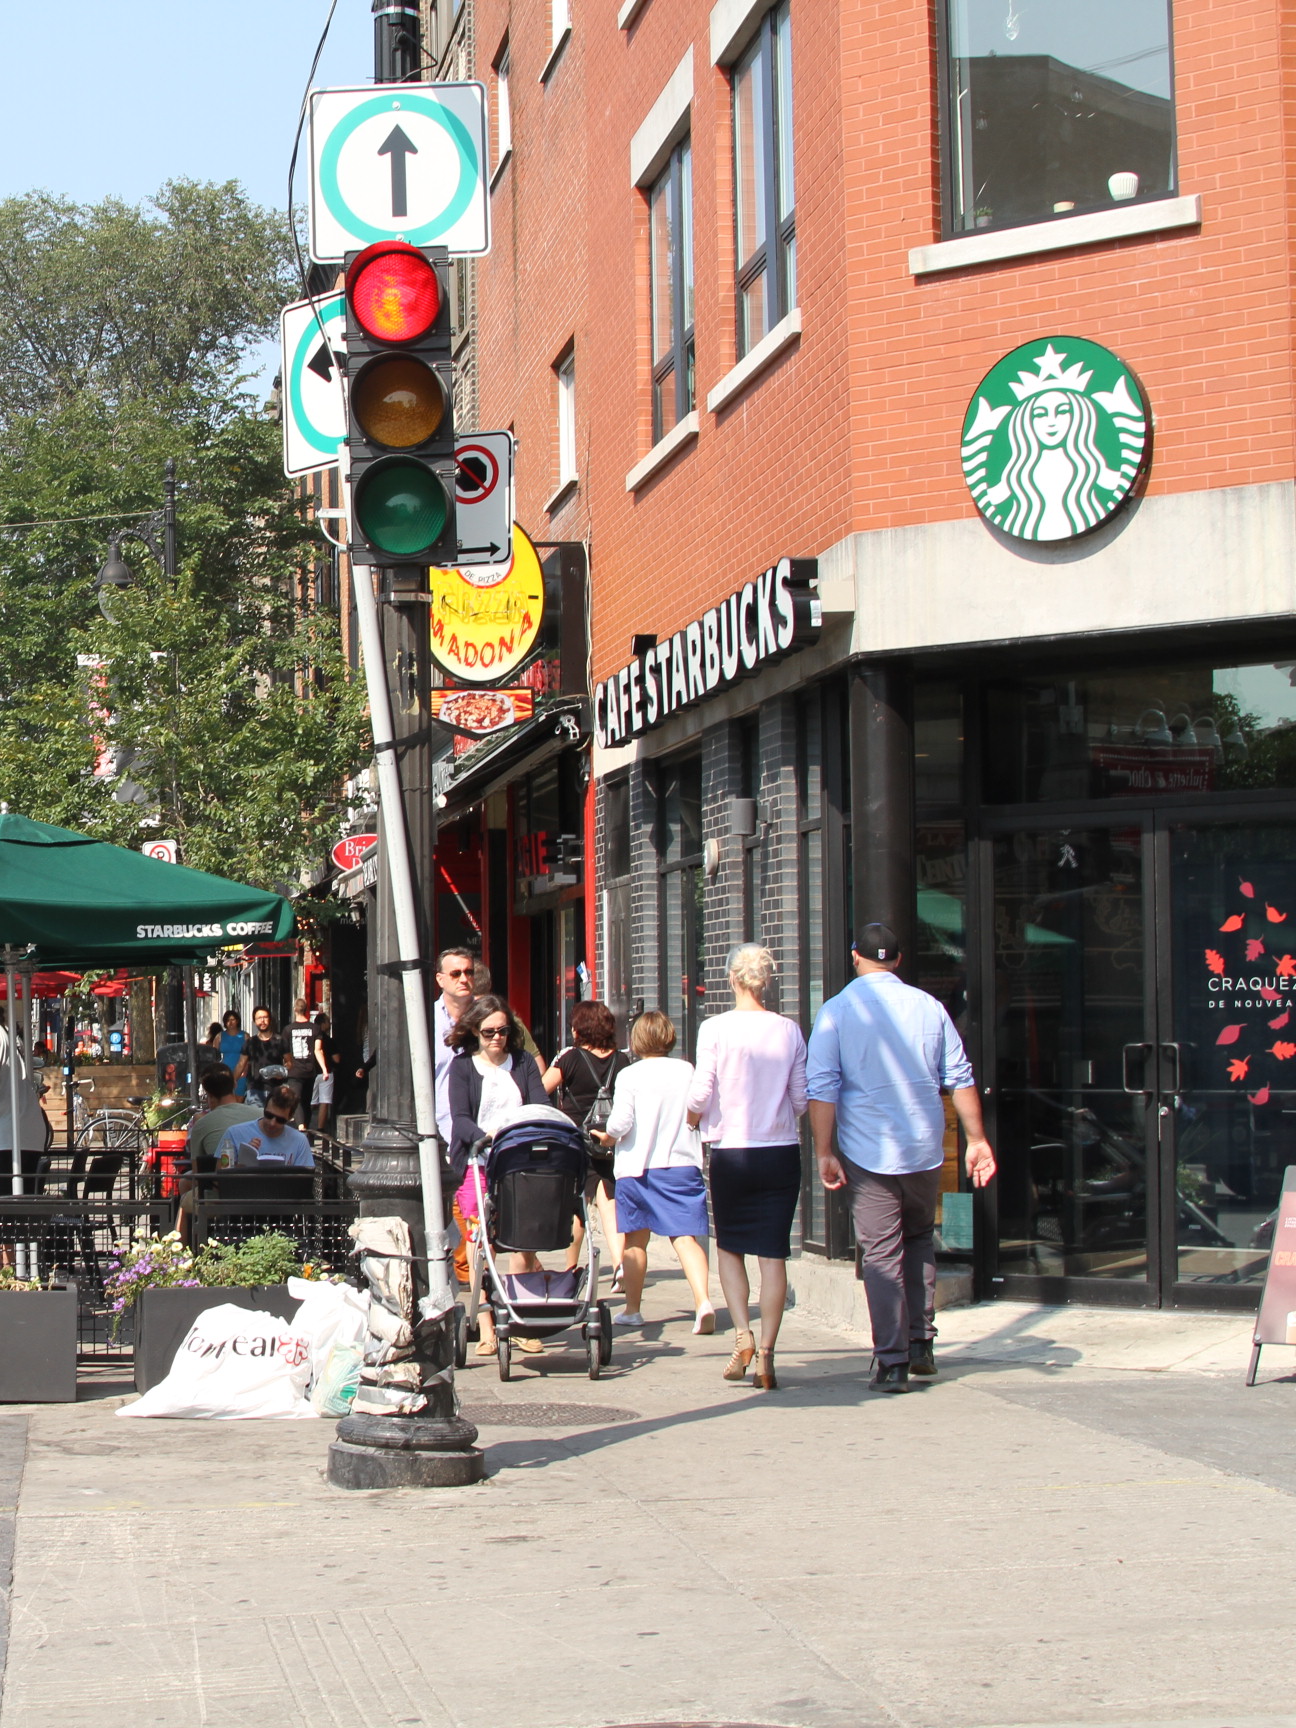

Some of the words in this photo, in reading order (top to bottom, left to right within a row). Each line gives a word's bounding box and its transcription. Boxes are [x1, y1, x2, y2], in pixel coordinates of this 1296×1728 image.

[644, 557, 795, 724] STARBUCKS
[136, 924, 223, 939] STARBUCKS
[226, 921, 273, 937] COFFEE
[1209, 1000, 1224, 1008] DE
